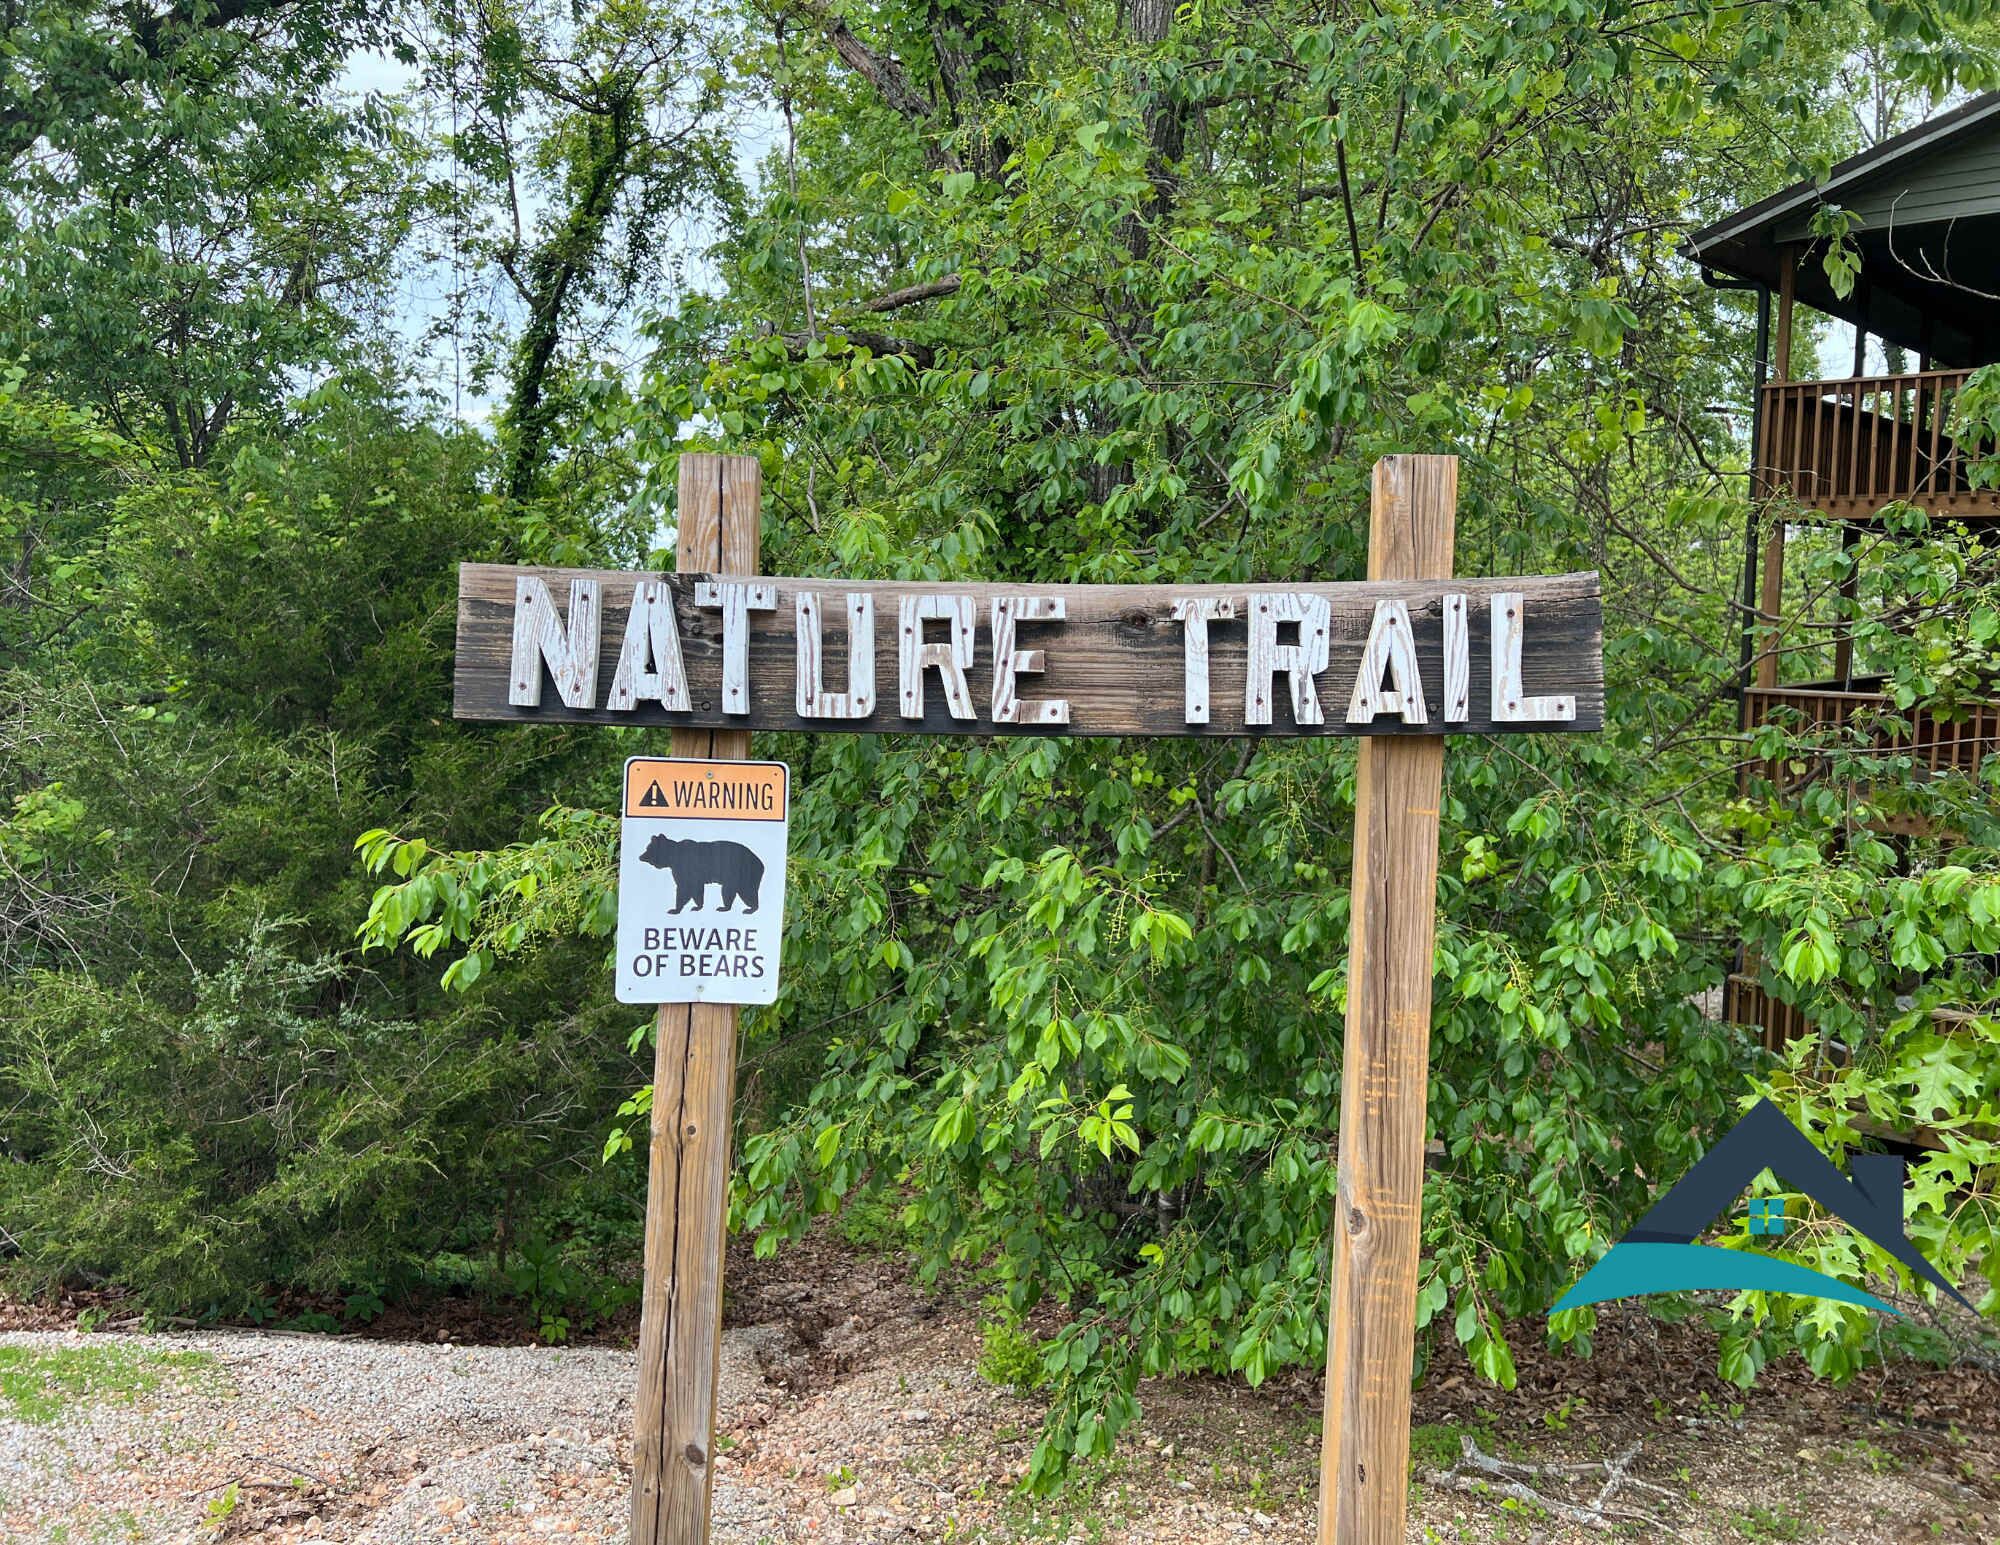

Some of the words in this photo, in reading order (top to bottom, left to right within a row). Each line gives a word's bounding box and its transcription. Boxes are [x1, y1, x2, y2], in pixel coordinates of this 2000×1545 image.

[508, 575, 1070, 725] NATURE
[1169, 592, 1577, 726] TRAIL
[673, 780, 774, 811] WARNING
[644, 927, 758, 951] BEWARE
[632, 954, 669, 977] OF
[680, 954, 764, 978] BEARS
